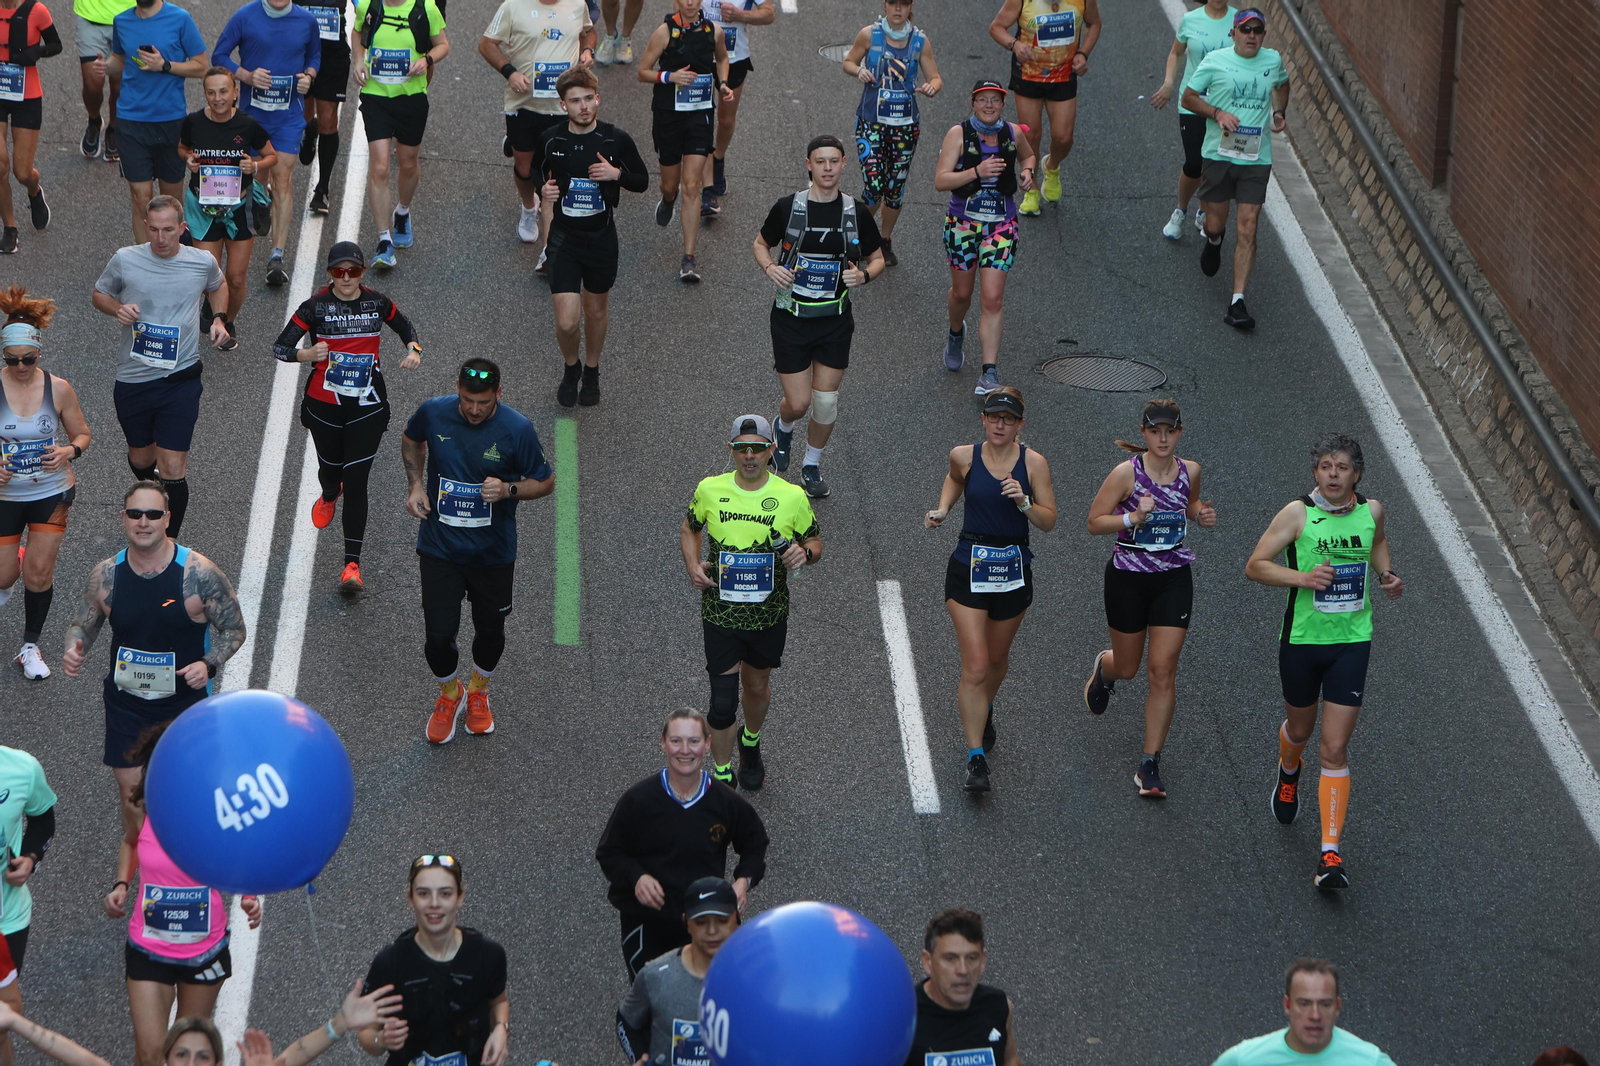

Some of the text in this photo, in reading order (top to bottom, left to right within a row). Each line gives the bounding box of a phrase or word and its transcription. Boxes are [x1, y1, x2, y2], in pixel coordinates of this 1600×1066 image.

[576, 181, 600, 189] ZURICH
[574, 194, 592, 202] 12332
[811, 263, 835, 271] ZURICH
[807, 274, 825, 283] 12255
[348, 313, 379, 321] PABLO
[147, 327, 174, 336] ZURICH
[145, 340, 163, 350] 12486
[143, 349, 163, 359] LUKASZ
[346, 356, 369, 364] ZURICH
[341, 370, 360, 378] 11619
[343, 379, 355, 387] ANA
[21, 442, 48, 451] ZURICH
[21, 457, 41, 466] 11330
[456, 486, 483, 494] ZURIC
[454, 500, 475, 509] 11872
[720, 510, 776, 527] DEPORTEMANIA
[1156, 513, 1182, 521] ZURICH
[991, 549, 1016, 558] ZURICH
[738, 557, 767, 565] ZURICH
[988, 565, 1009, 573] 12564
[1335, 566, 1361, 575] ZURICH
[735, 573, 757, 581] 11583
[734, 583, 758, 591] ROCDAN
[135, 655, 167, 664] ZURICH
[133, 671, 156, 680] 10195
[138, 682, 151, 690] JIM
[214, 763, 289, 832] 4:30
[166, 891, 203, 900] ZURICH
[163, 909, 189, 920] 12538
[168, 923, 183, 931] EVA
[694, 1045, 707, 1056] 12
[951, 1054, 986, 1066] ZURICH
